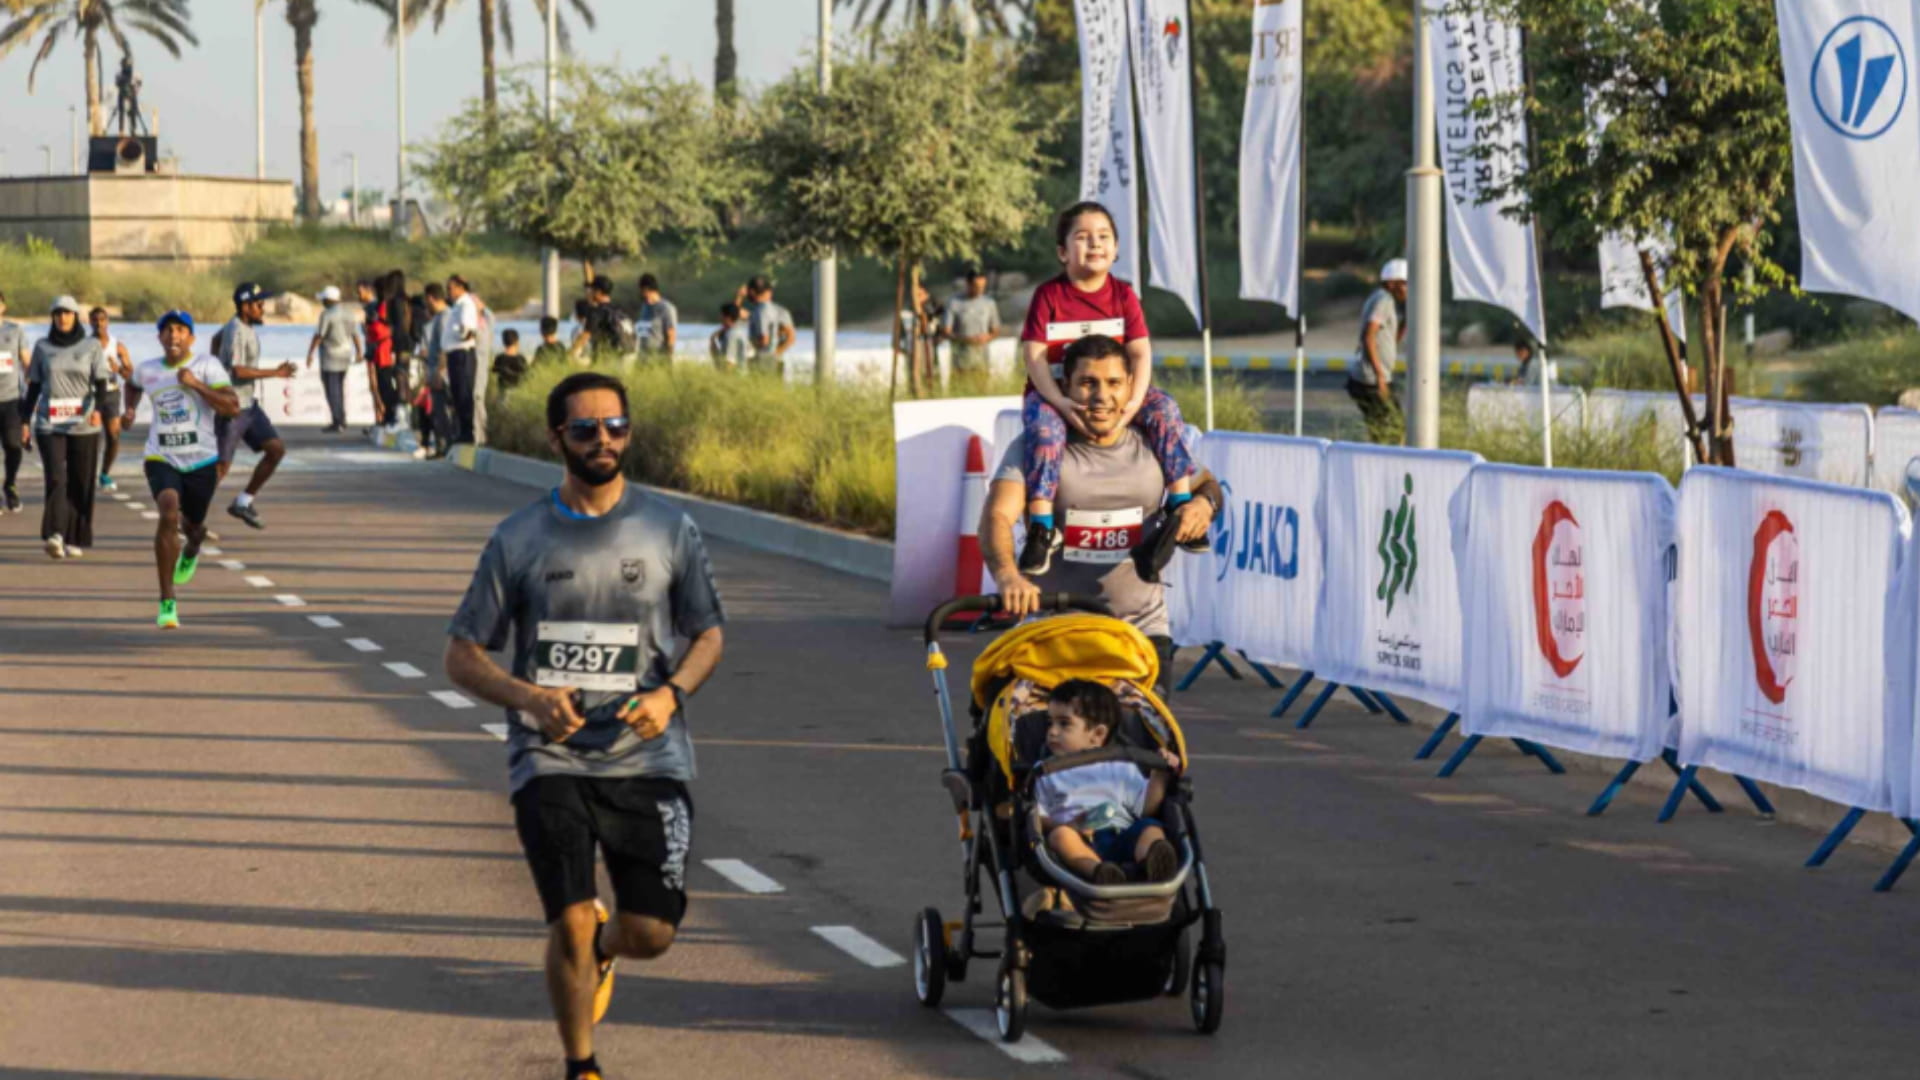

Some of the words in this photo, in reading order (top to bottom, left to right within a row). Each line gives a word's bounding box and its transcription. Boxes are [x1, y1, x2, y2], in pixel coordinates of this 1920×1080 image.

[1079, 529, 1129, 548] 2186
[1236, 500, 1299, 580] JAKO
[549, 642, 622, 673] 6297
